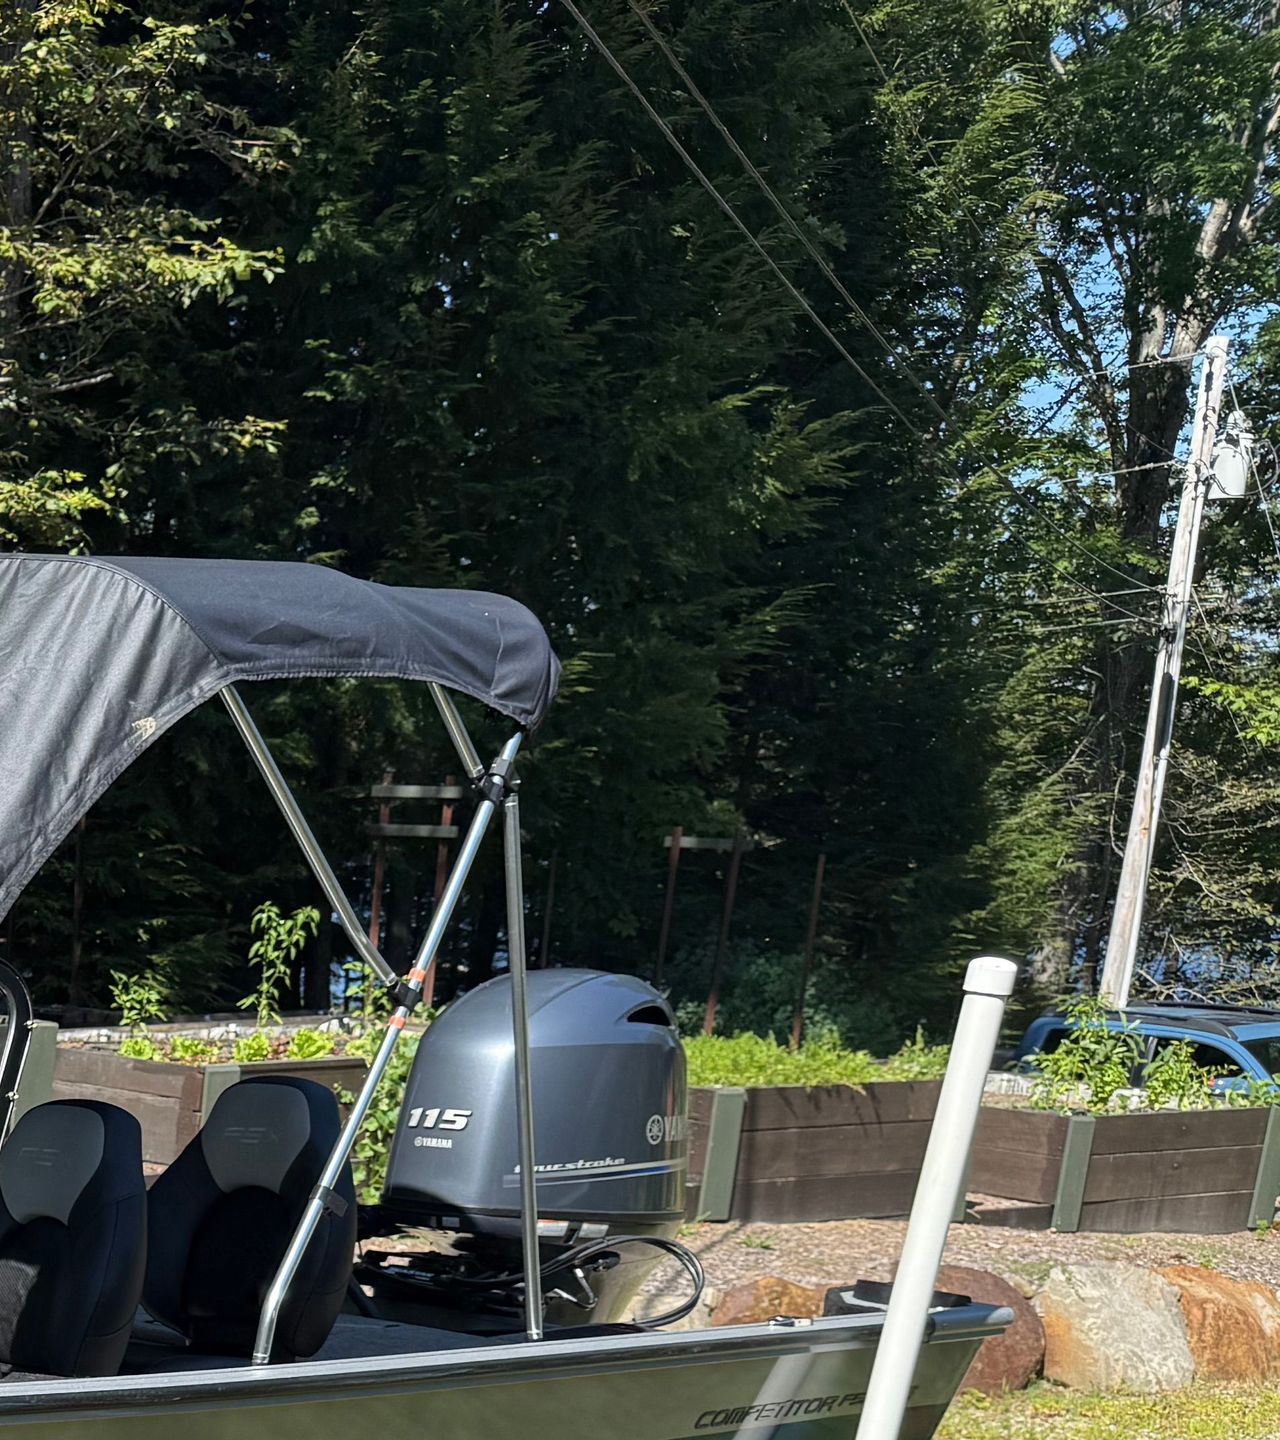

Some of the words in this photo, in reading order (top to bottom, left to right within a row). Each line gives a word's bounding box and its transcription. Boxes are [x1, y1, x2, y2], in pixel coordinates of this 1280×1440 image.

[408, 1107, 473, 1131] 115
[421, 1137, 453, 1149] YAMAHA
[694, 1394, 838, 1430] COMPETITOR
